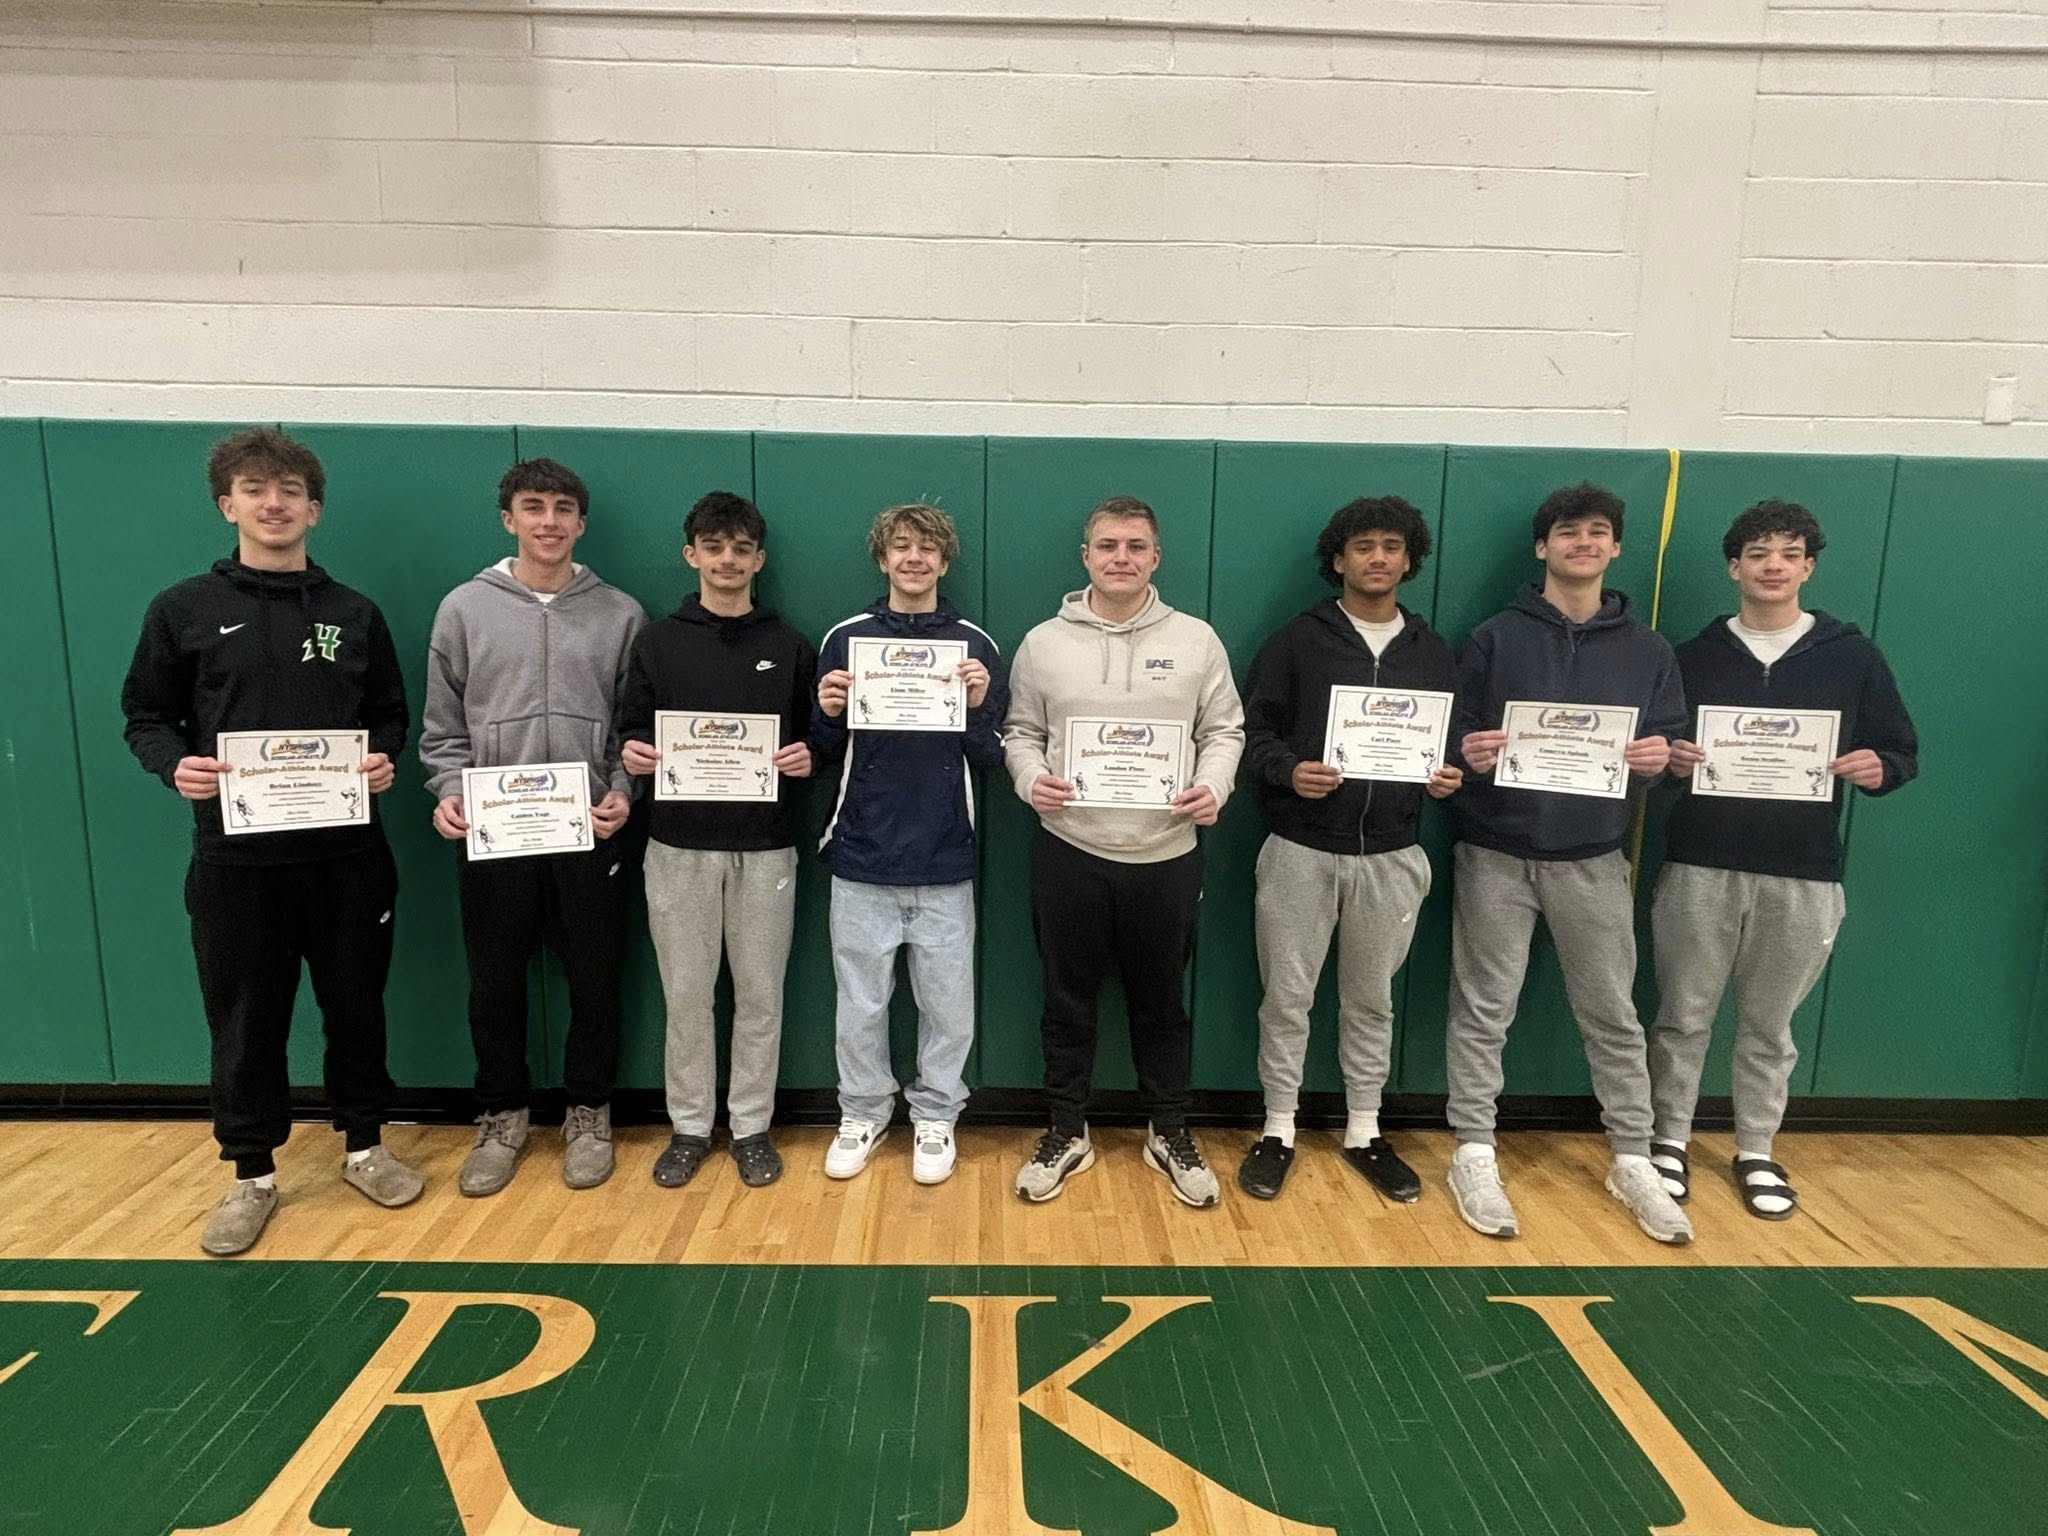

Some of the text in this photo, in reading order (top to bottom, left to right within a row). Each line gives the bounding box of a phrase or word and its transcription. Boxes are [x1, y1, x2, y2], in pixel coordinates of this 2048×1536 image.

[865, 671, 924, 680] Scholar-Athlete
[1343, 720, 1431, 734] Scholar-Athlete Award
[1518, 731, 1615, 748] Scholar-Athlete Award
[1713, 739, 1817, 752] Scholar-Athlete Award
[673, 743, 763, 754] Scholar-Athlete Award
[1081, 749, 1169, 761] Scholar-Athlete Award
[239, 764, 349, 778] Scholar-Athlete Award
[482, 795, 575, 810] Scholar-Athlete Award
